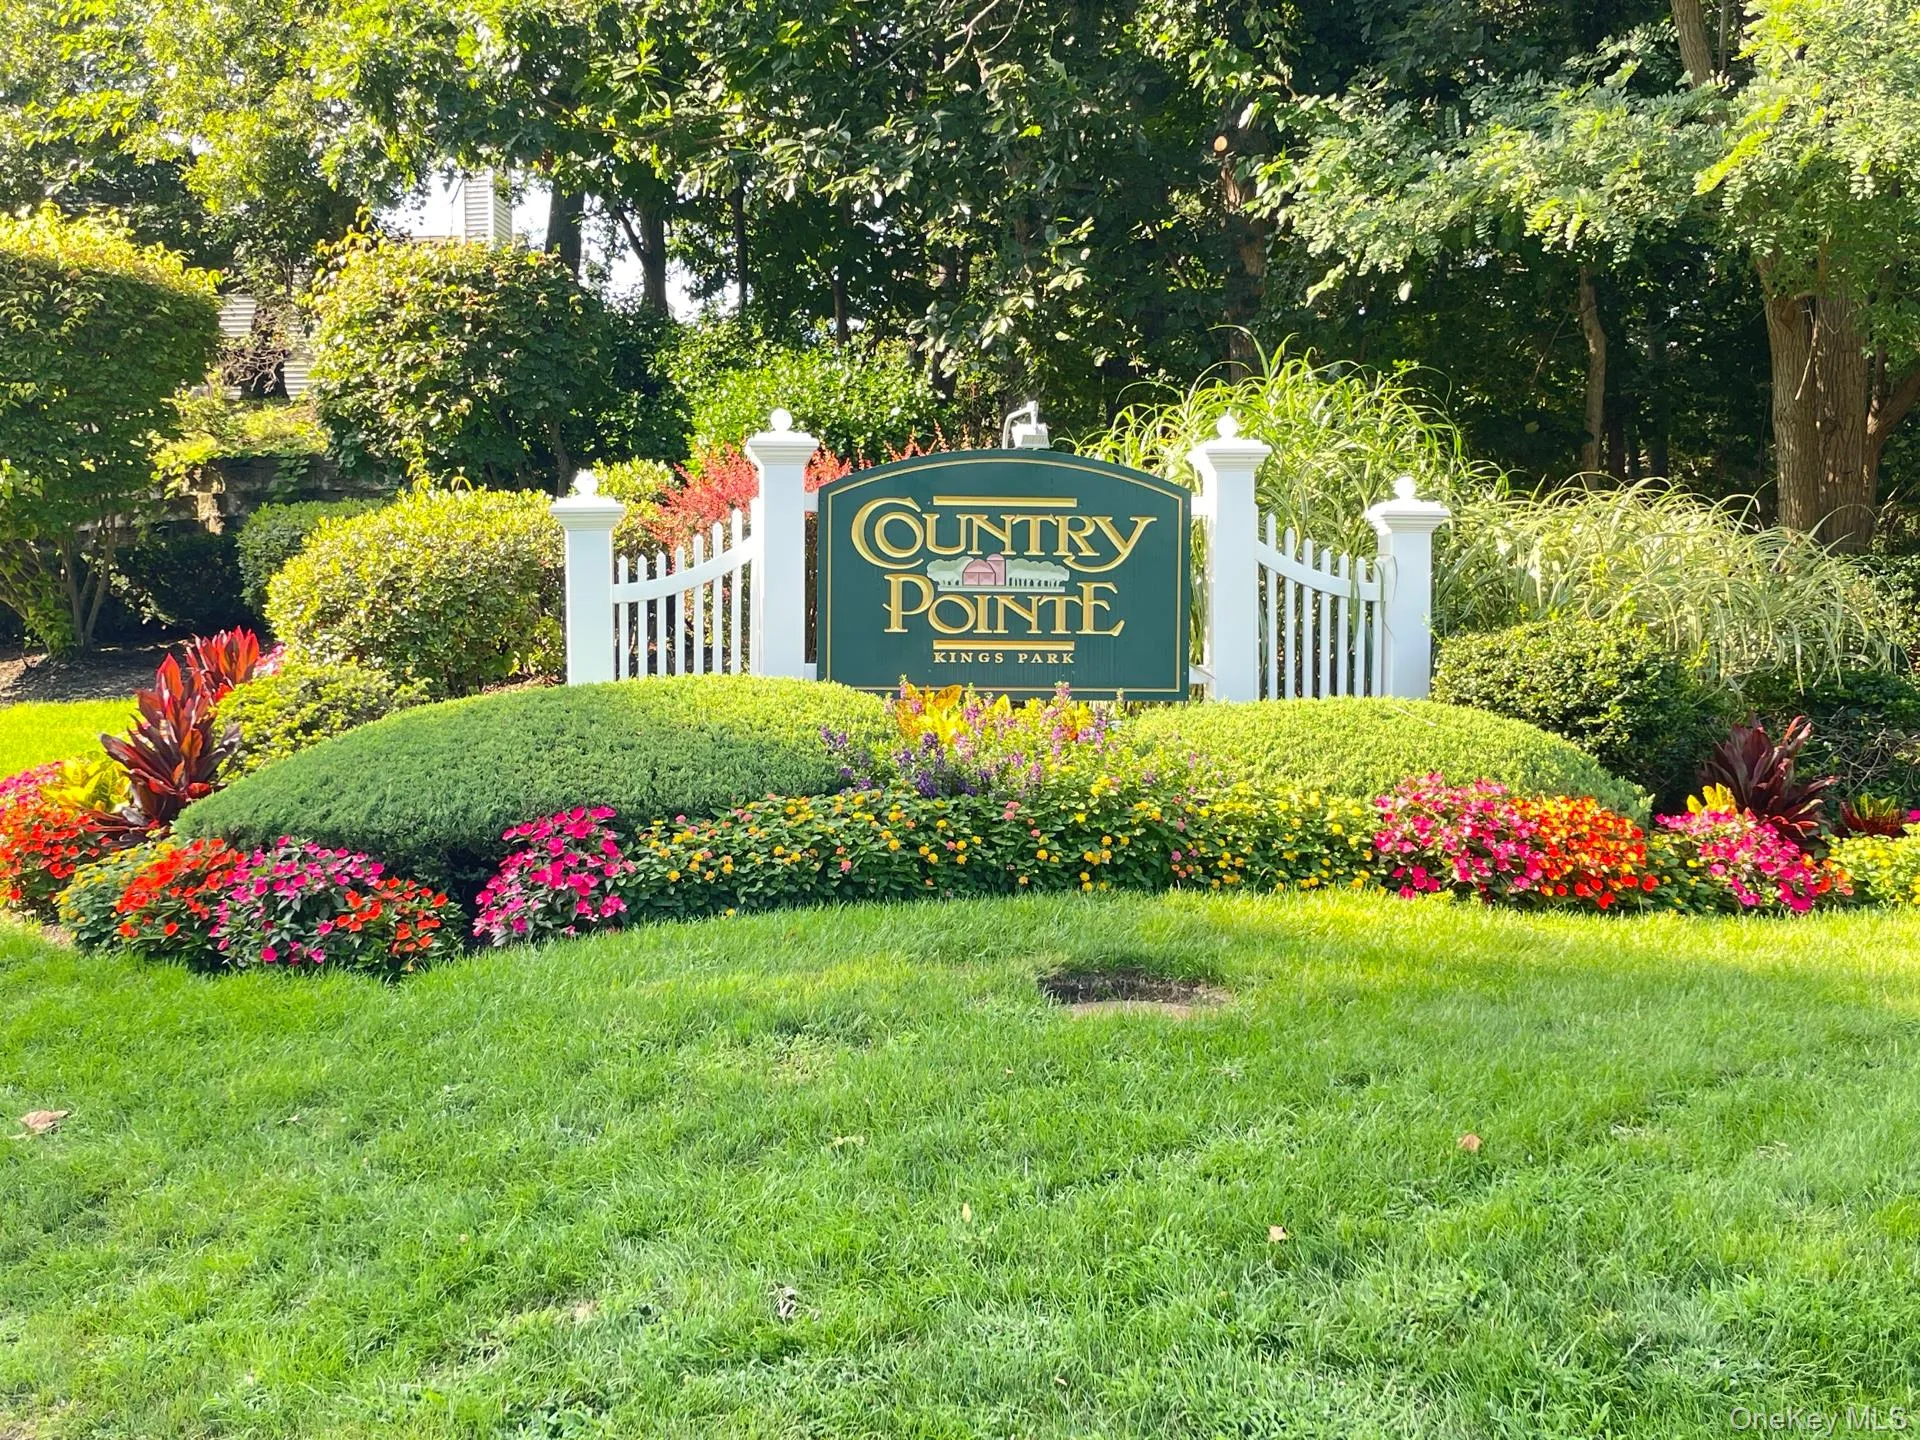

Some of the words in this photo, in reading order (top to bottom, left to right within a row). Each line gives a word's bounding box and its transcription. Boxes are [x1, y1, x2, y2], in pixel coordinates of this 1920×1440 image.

[851, 497, 1157, 573] COUNTRY
[882, 573, 1125, 637] POINTE
[933, 652, 1005, 664] KINGS
[1018, 653, 1075, 664] PARK
